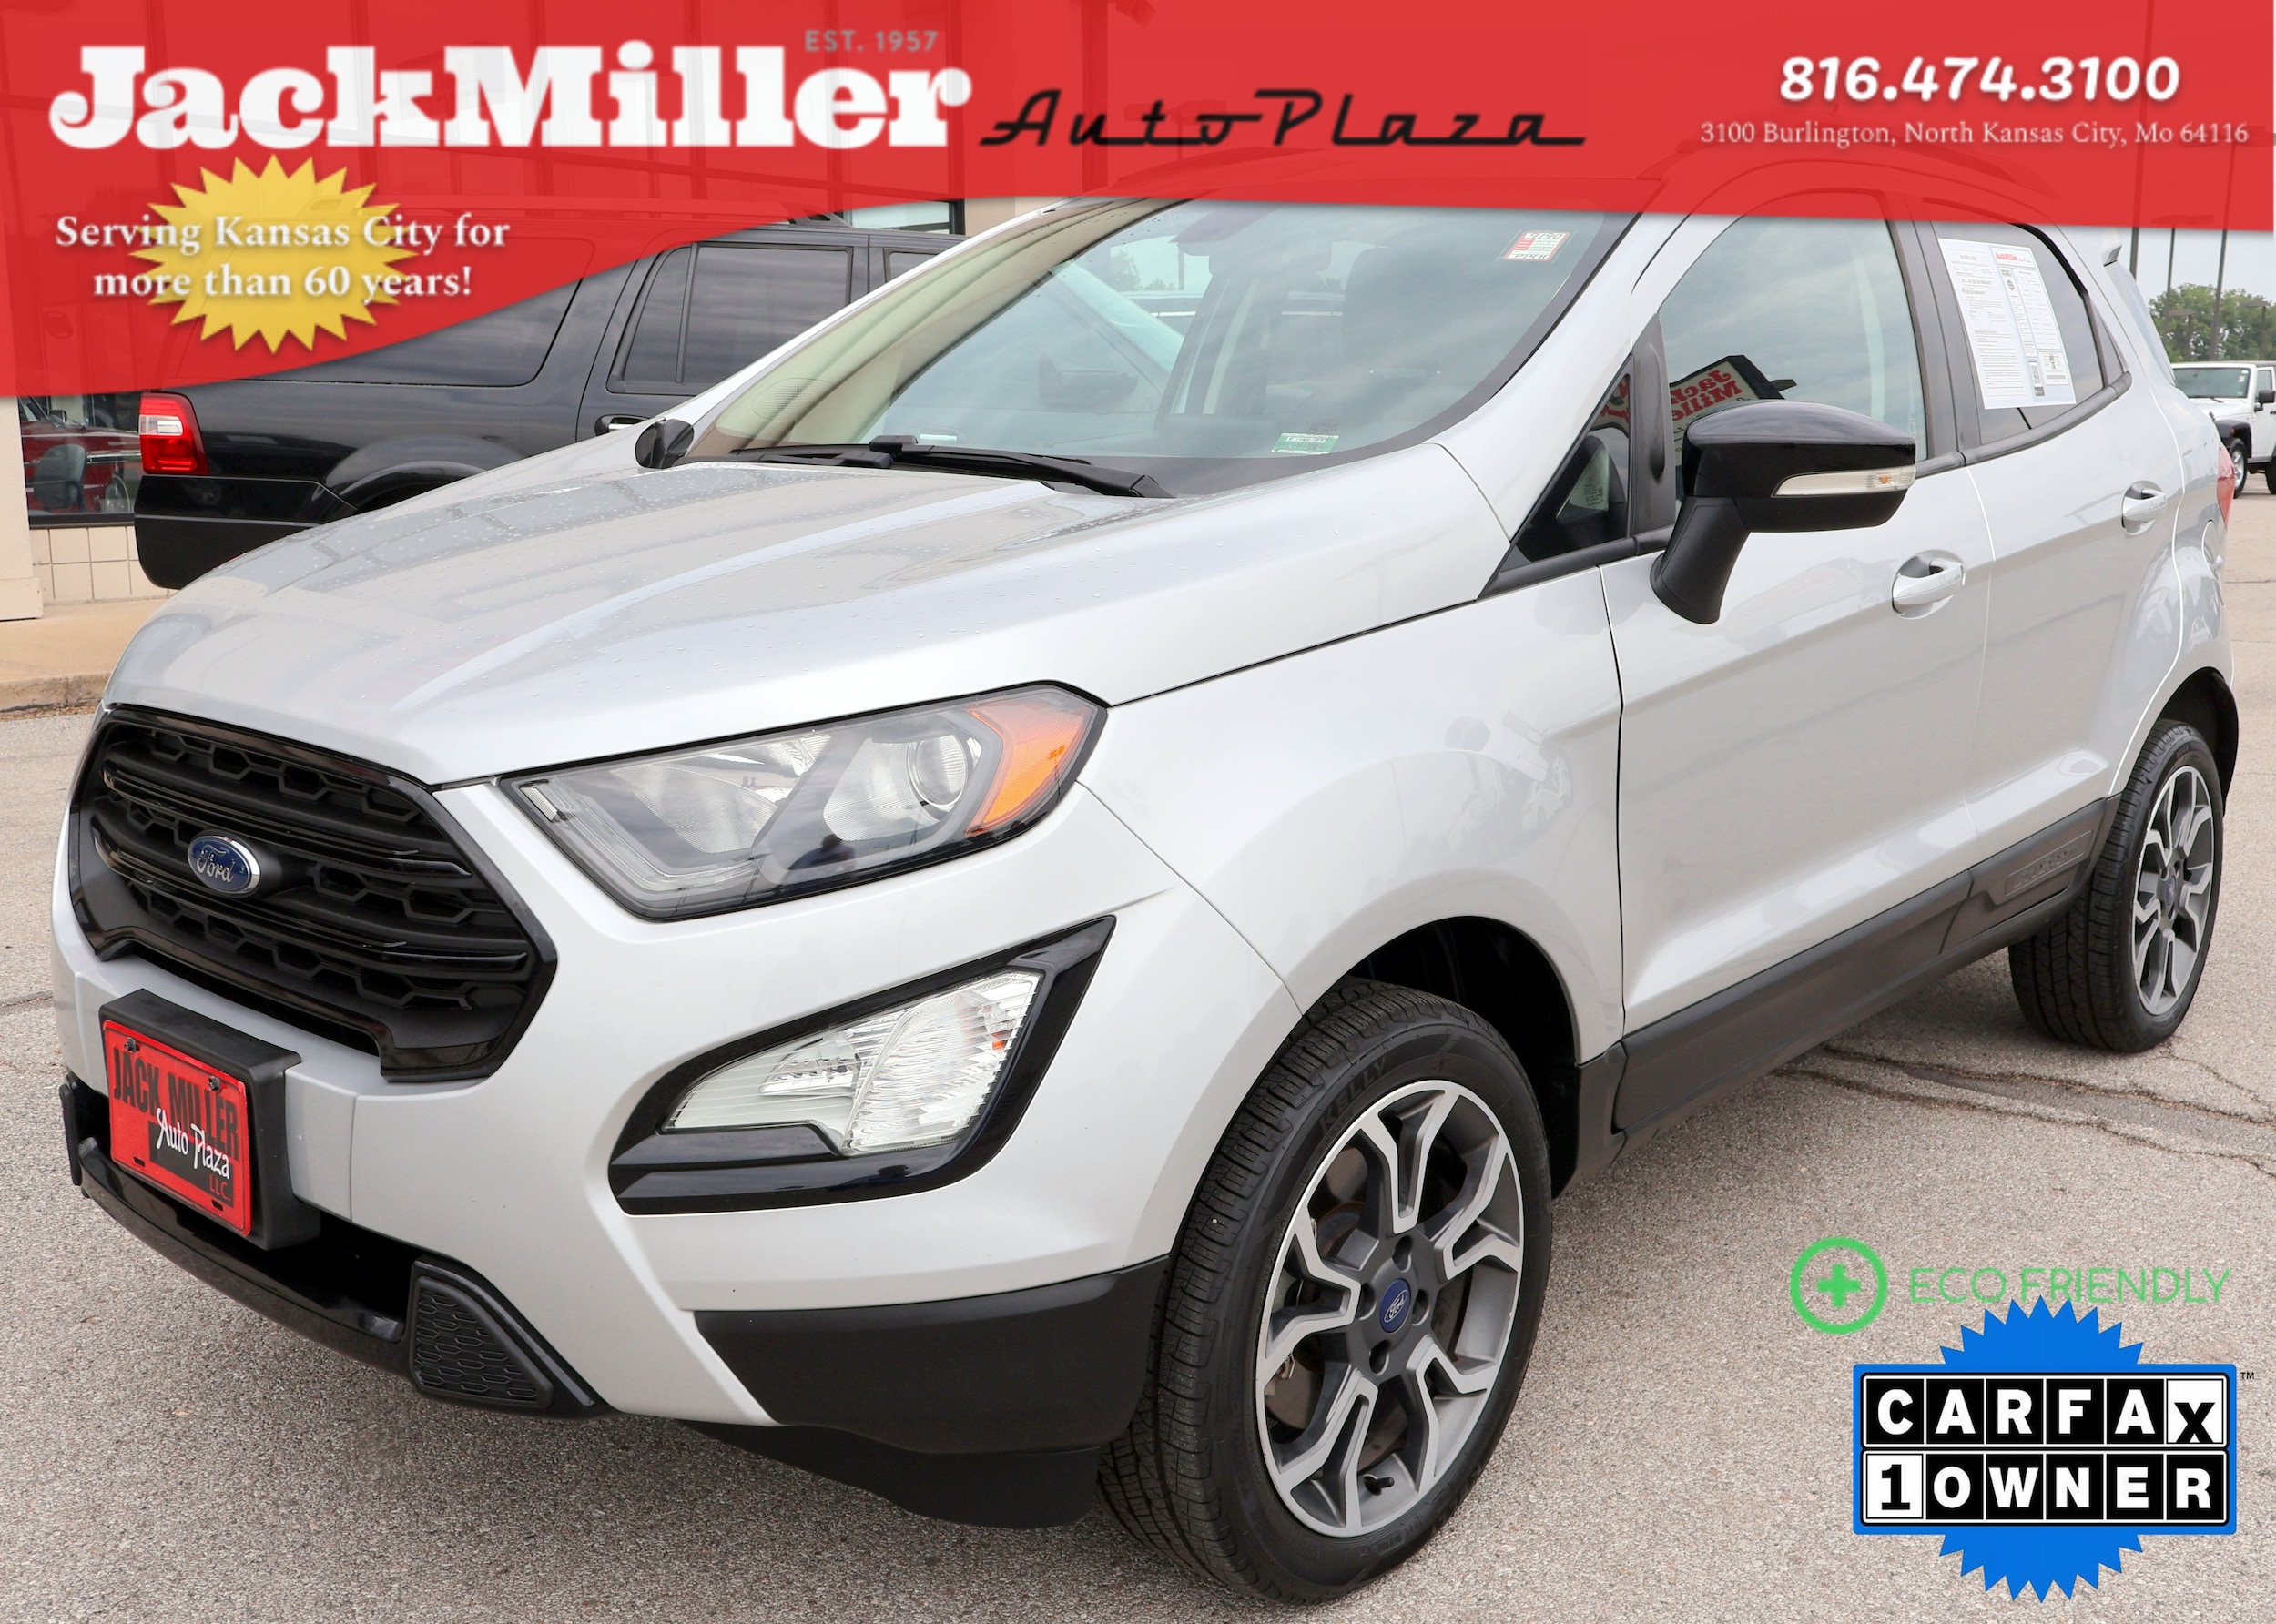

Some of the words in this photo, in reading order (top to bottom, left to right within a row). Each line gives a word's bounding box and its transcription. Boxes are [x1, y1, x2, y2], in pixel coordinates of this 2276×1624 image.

[196, 844, 235, 883] Ford
[113, 1047, 160, 1118] JACK
[168, 1072, 239, 1162] MILLER
[1319, 1056, 1387, 1135] KELLY
[156, 1107, 189, 1155] Auto
[190, 1122, 230, 1180] Plaza
